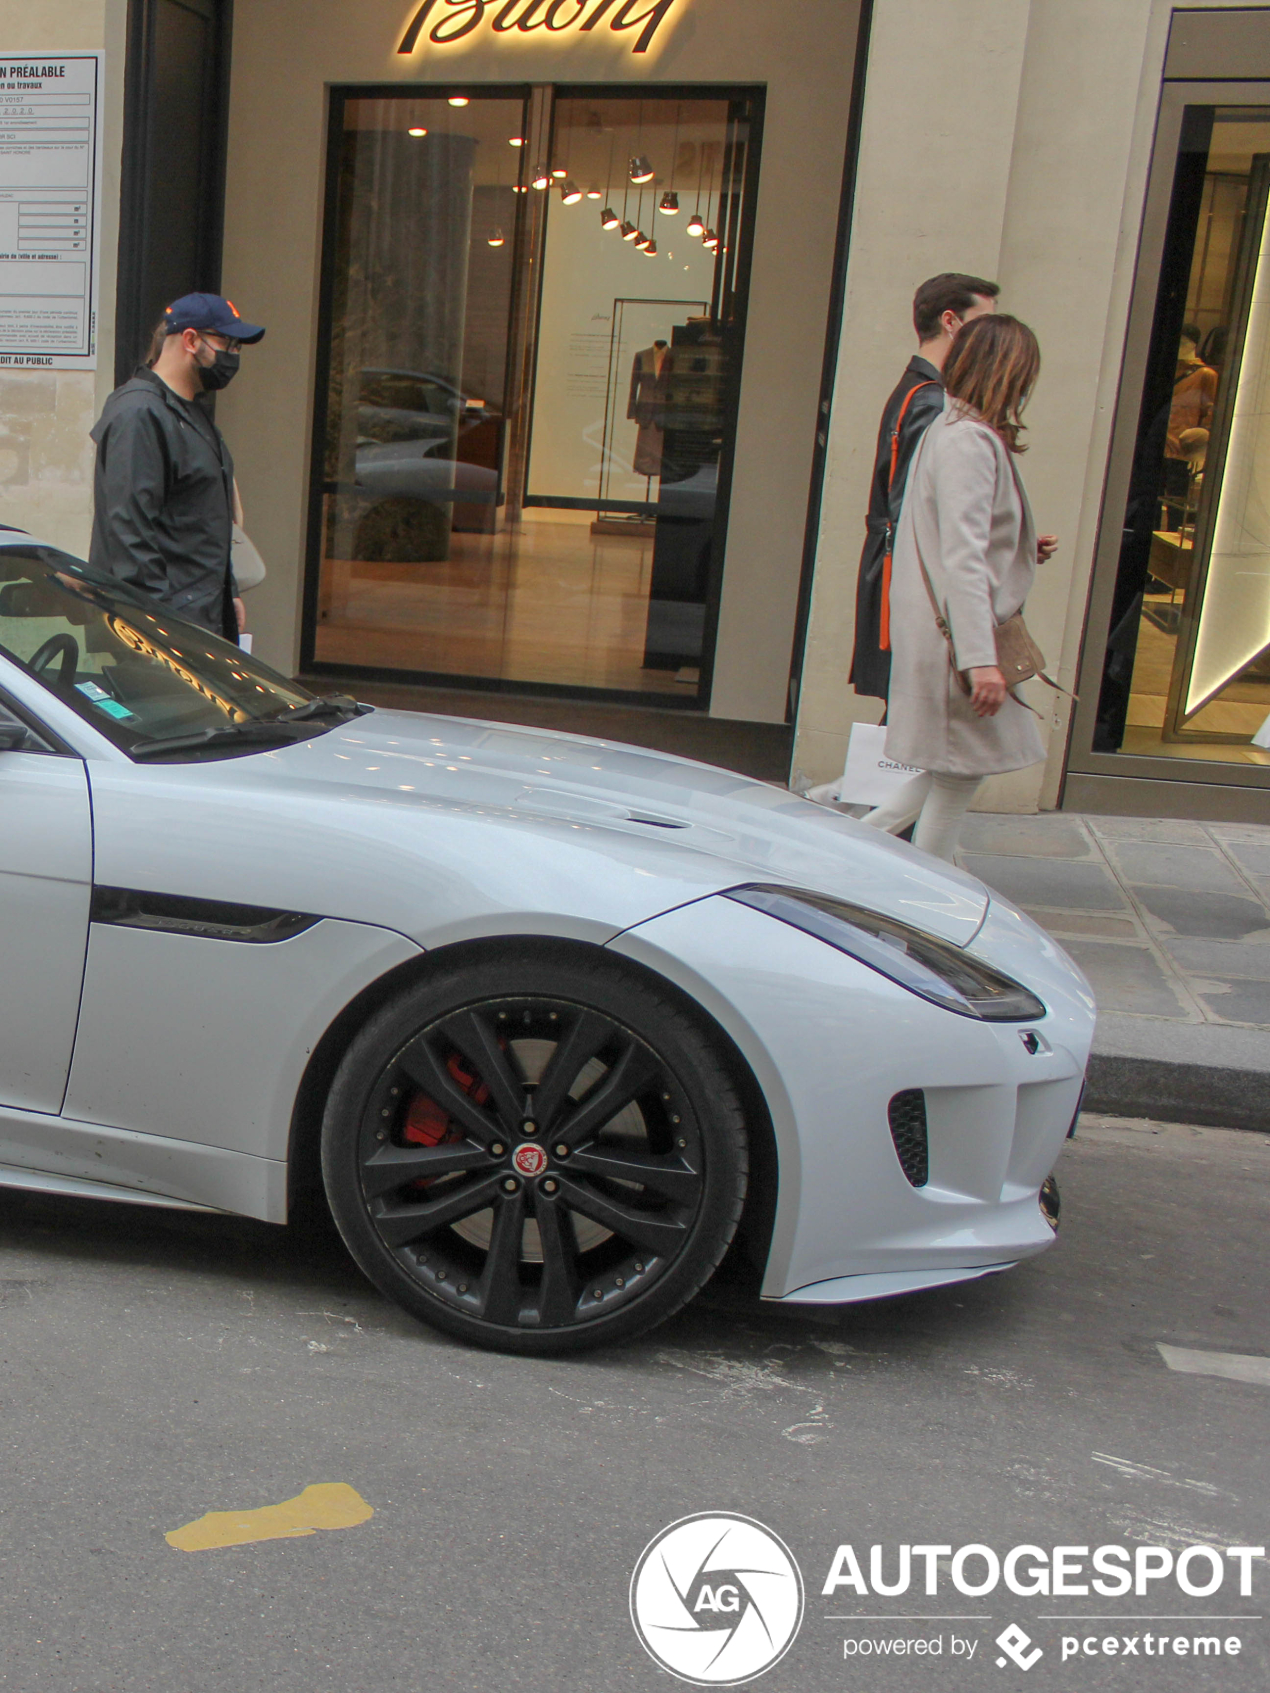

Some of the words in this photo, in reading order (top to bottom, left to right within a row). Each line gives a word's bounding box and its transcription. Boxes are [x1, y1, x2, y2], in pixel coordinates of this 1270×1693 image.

[10, 64, 66, 78] PRÉALABLE
[17, 81, 43, 89] travaux
[14, 356, 24, 364] AU
[26, 356, 53, 365] PUBLIC
[877, 761, 921, 773] CHANEL
